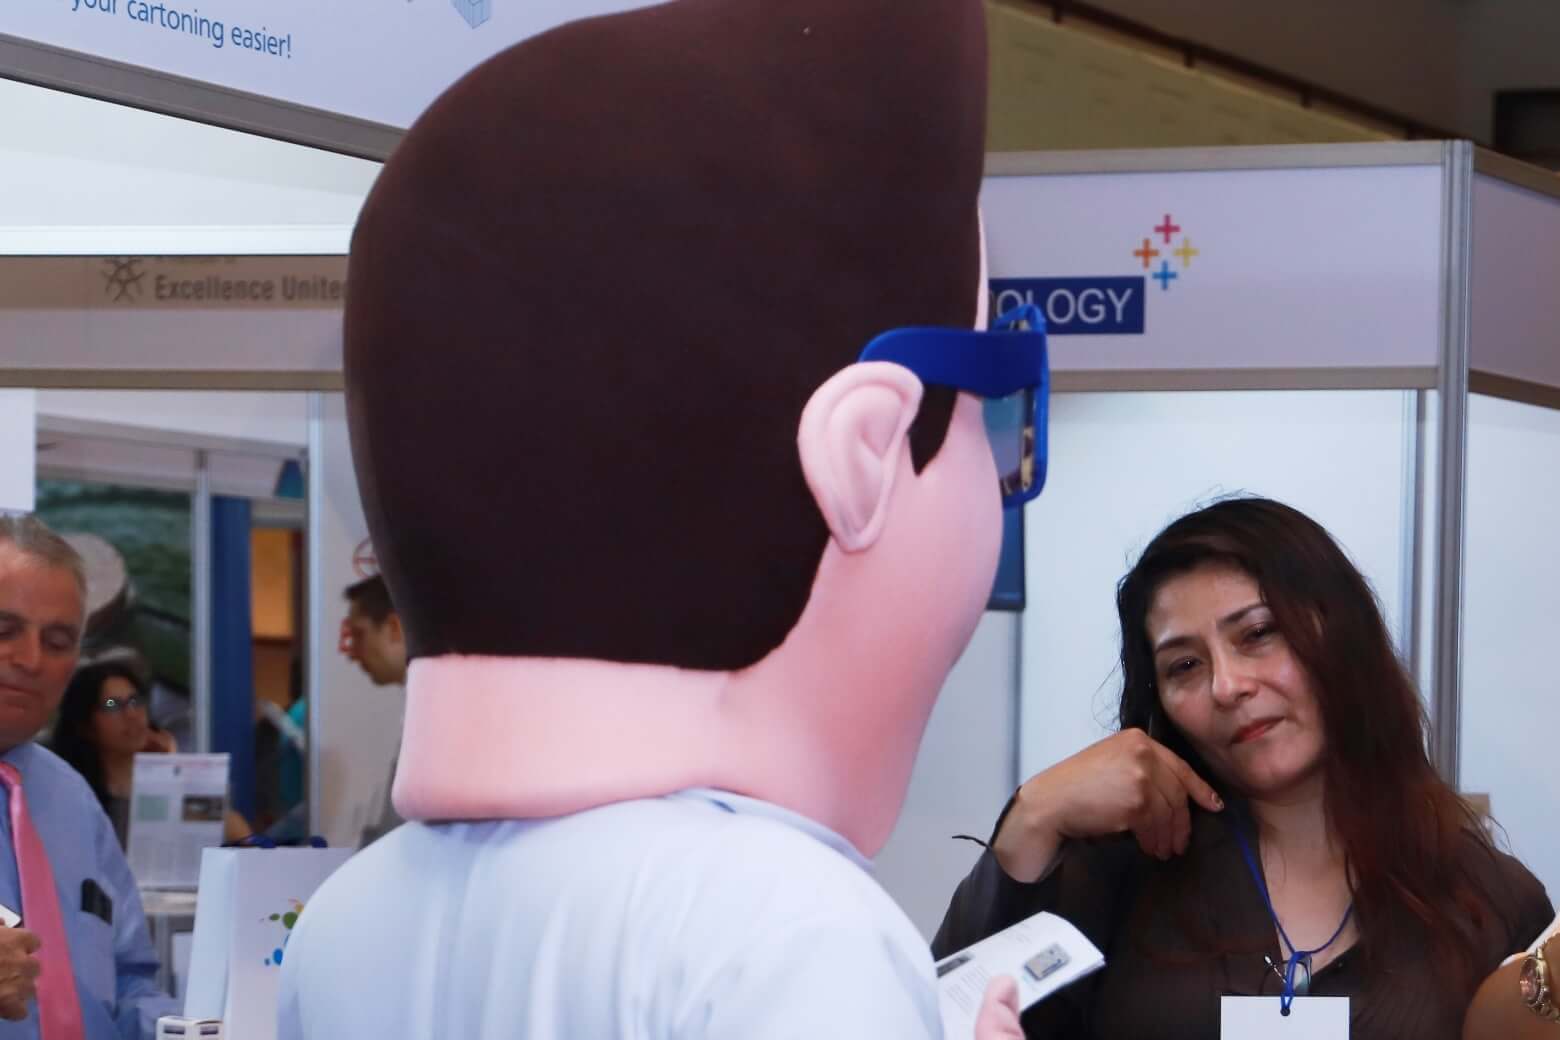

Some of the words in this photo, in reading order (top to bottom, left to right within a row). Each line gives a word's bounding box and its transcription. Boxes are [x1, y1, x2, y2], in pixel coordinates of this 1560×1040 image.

[127, 0, 224, 48] cartoning
[231, 26, 292, 58] easier!
[154, 274, 275, 300] Excellence
